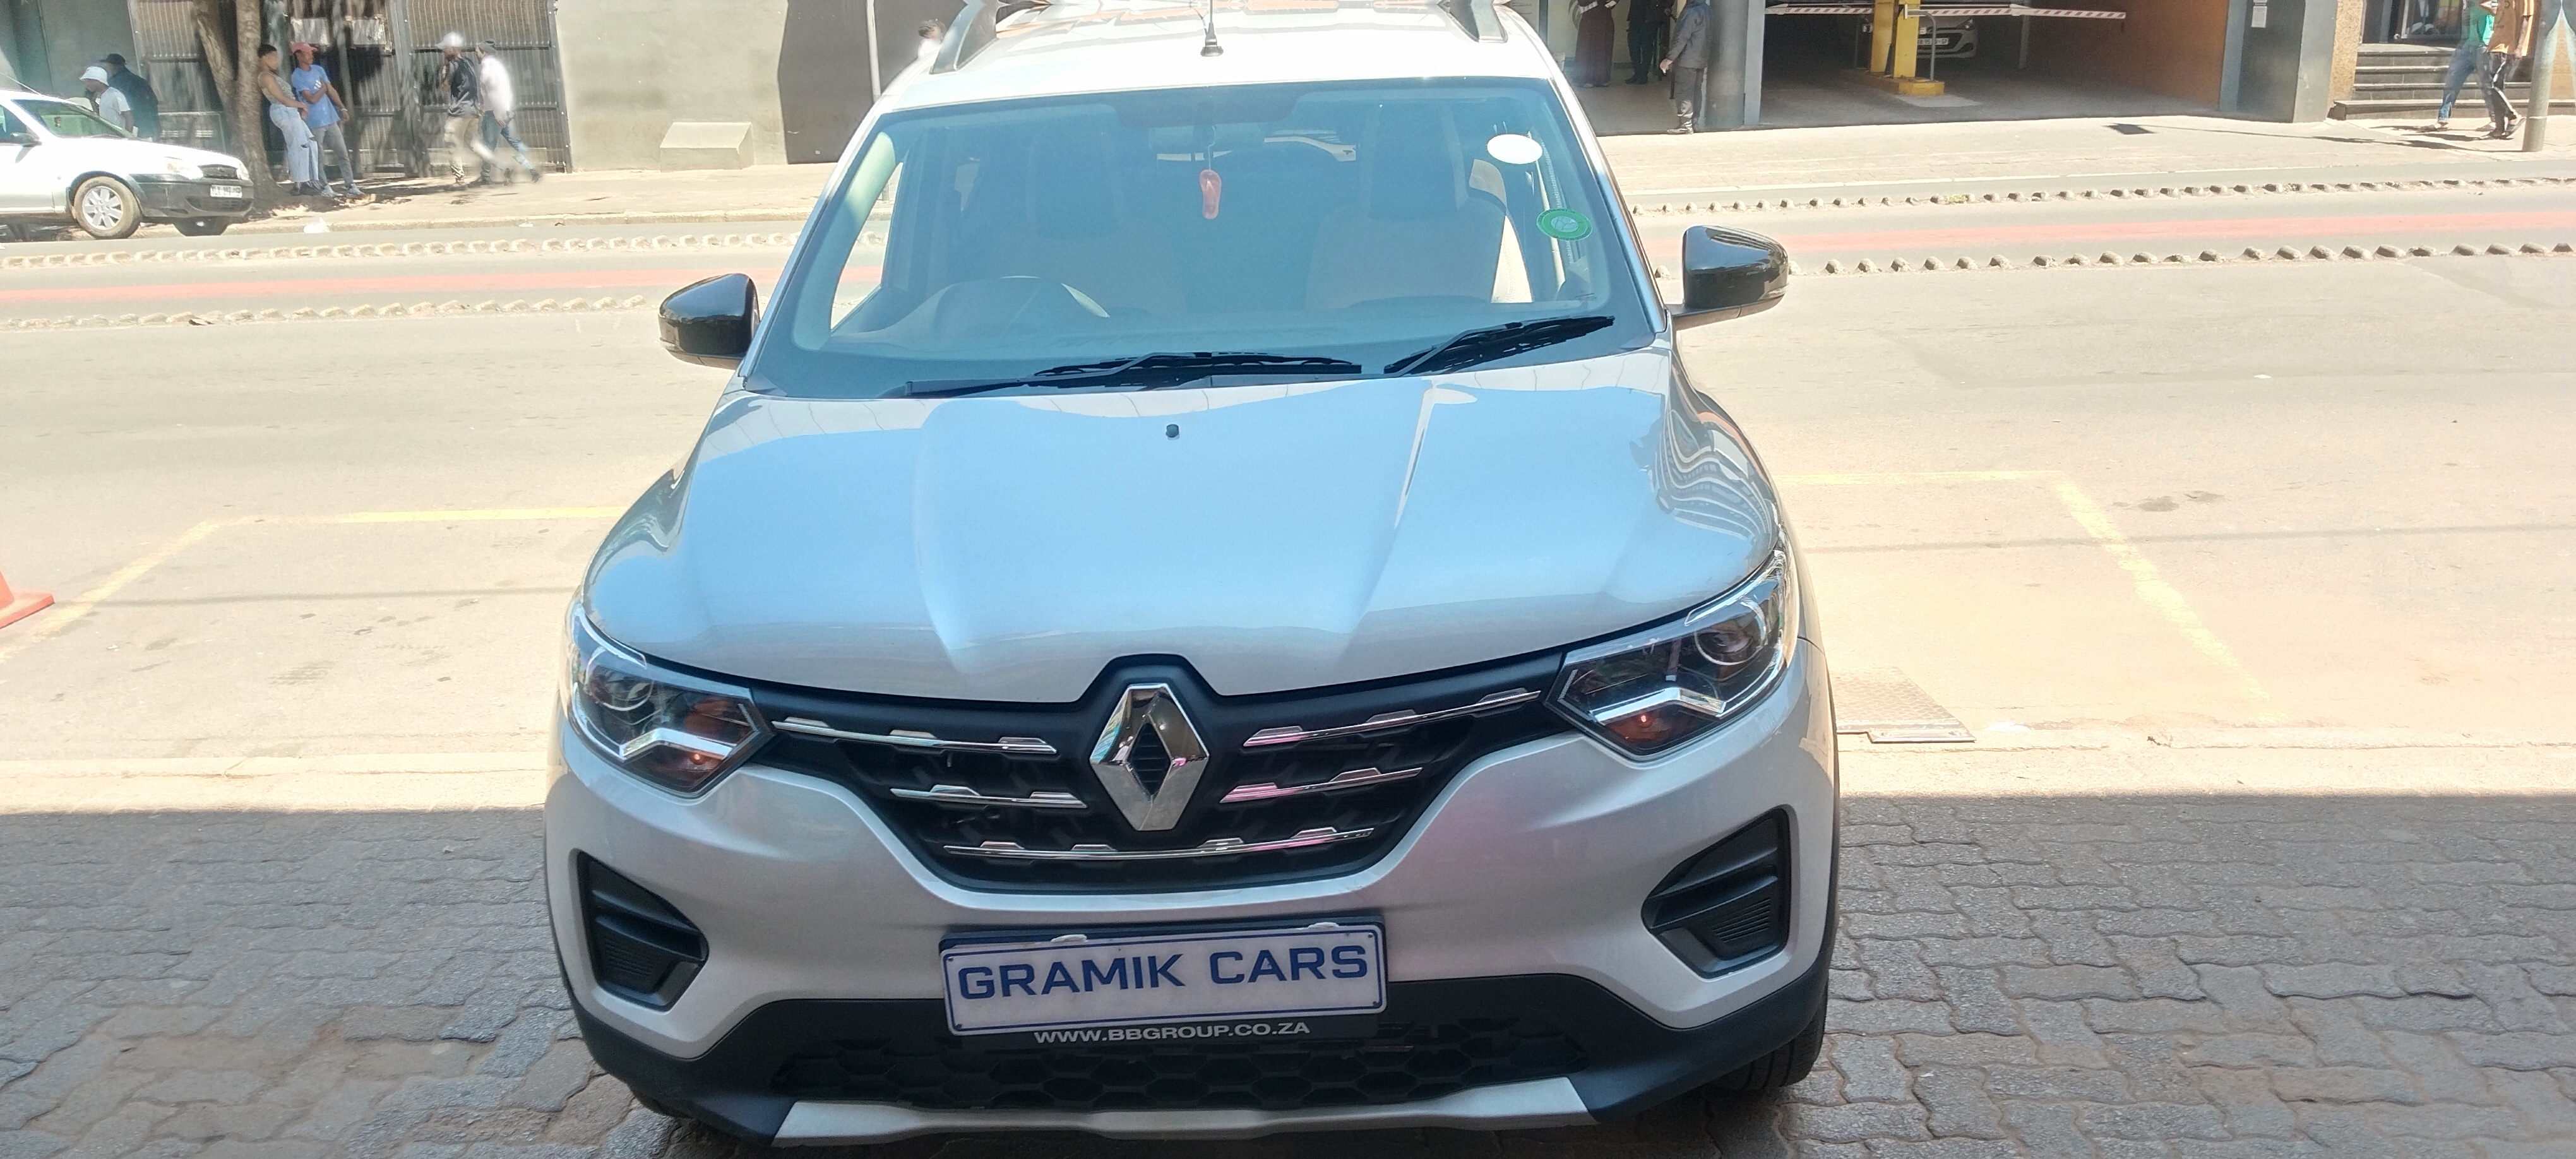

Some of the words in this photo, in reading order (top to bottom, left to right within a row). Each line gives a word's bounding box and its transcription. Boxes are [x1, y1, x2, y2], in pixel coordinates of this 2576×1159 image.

[958, 954, 1186, 999] GRAMIK
[1209, 945, 1368, 985] CARS
[1034, 1022, 1311, 1043] WWW.BBGROUP.CO.ZA
